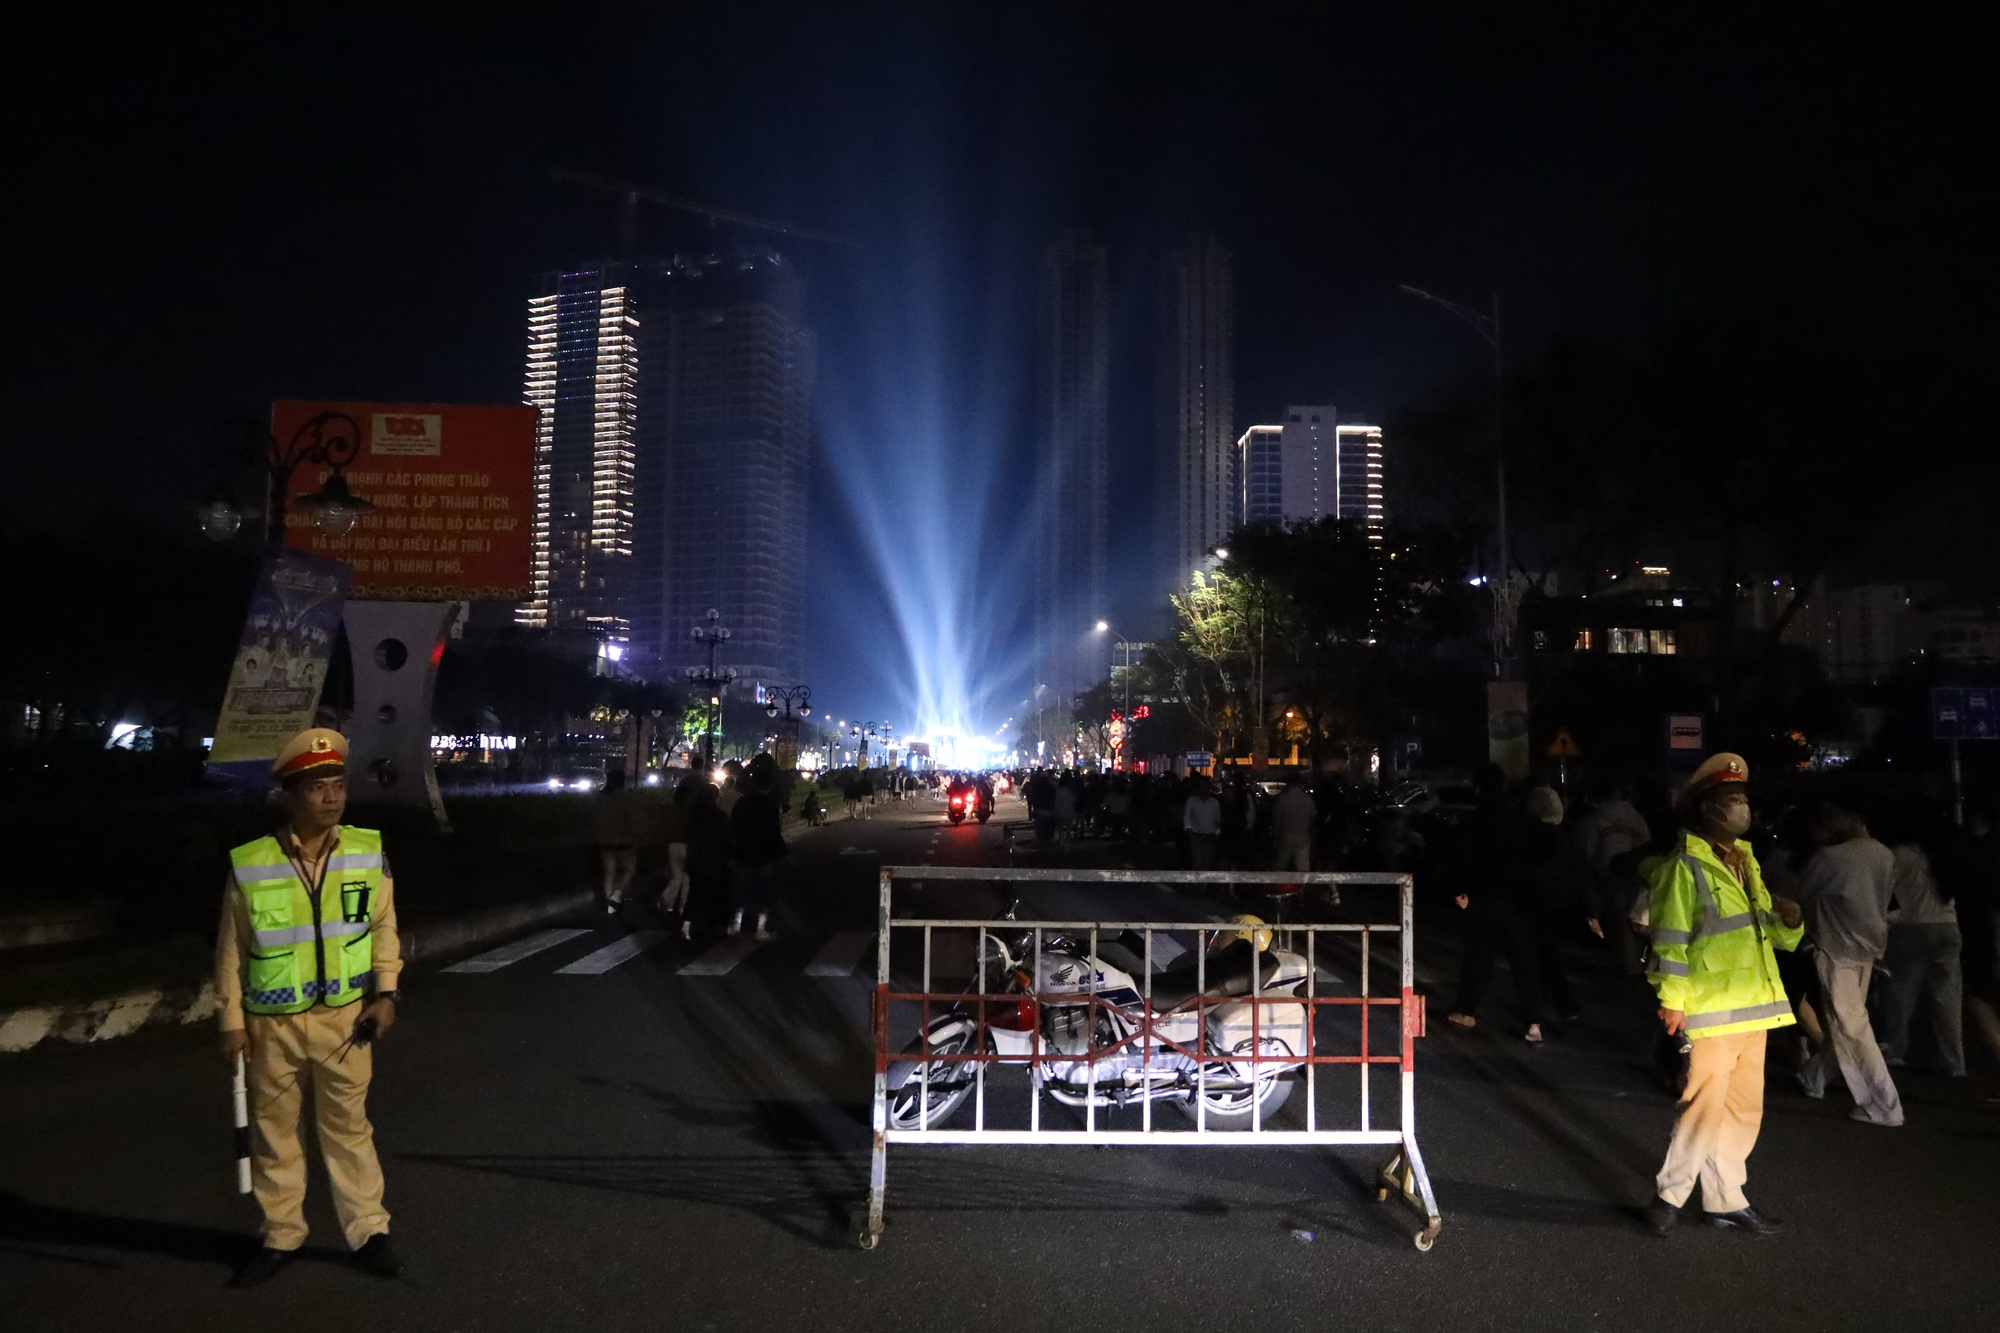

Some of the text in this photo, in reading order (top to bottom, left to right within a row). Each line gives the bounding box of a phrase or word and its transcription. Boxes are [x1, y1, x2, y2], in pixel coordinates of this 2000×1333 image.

[414, 473, 455, 487] PHONG
[440, 493, 479, 508] THÀNH
[482, 494, 509, 509] TÍCH
[466, 515, 490, 531] CÁC
[1406, 742, 1418, 754] P
